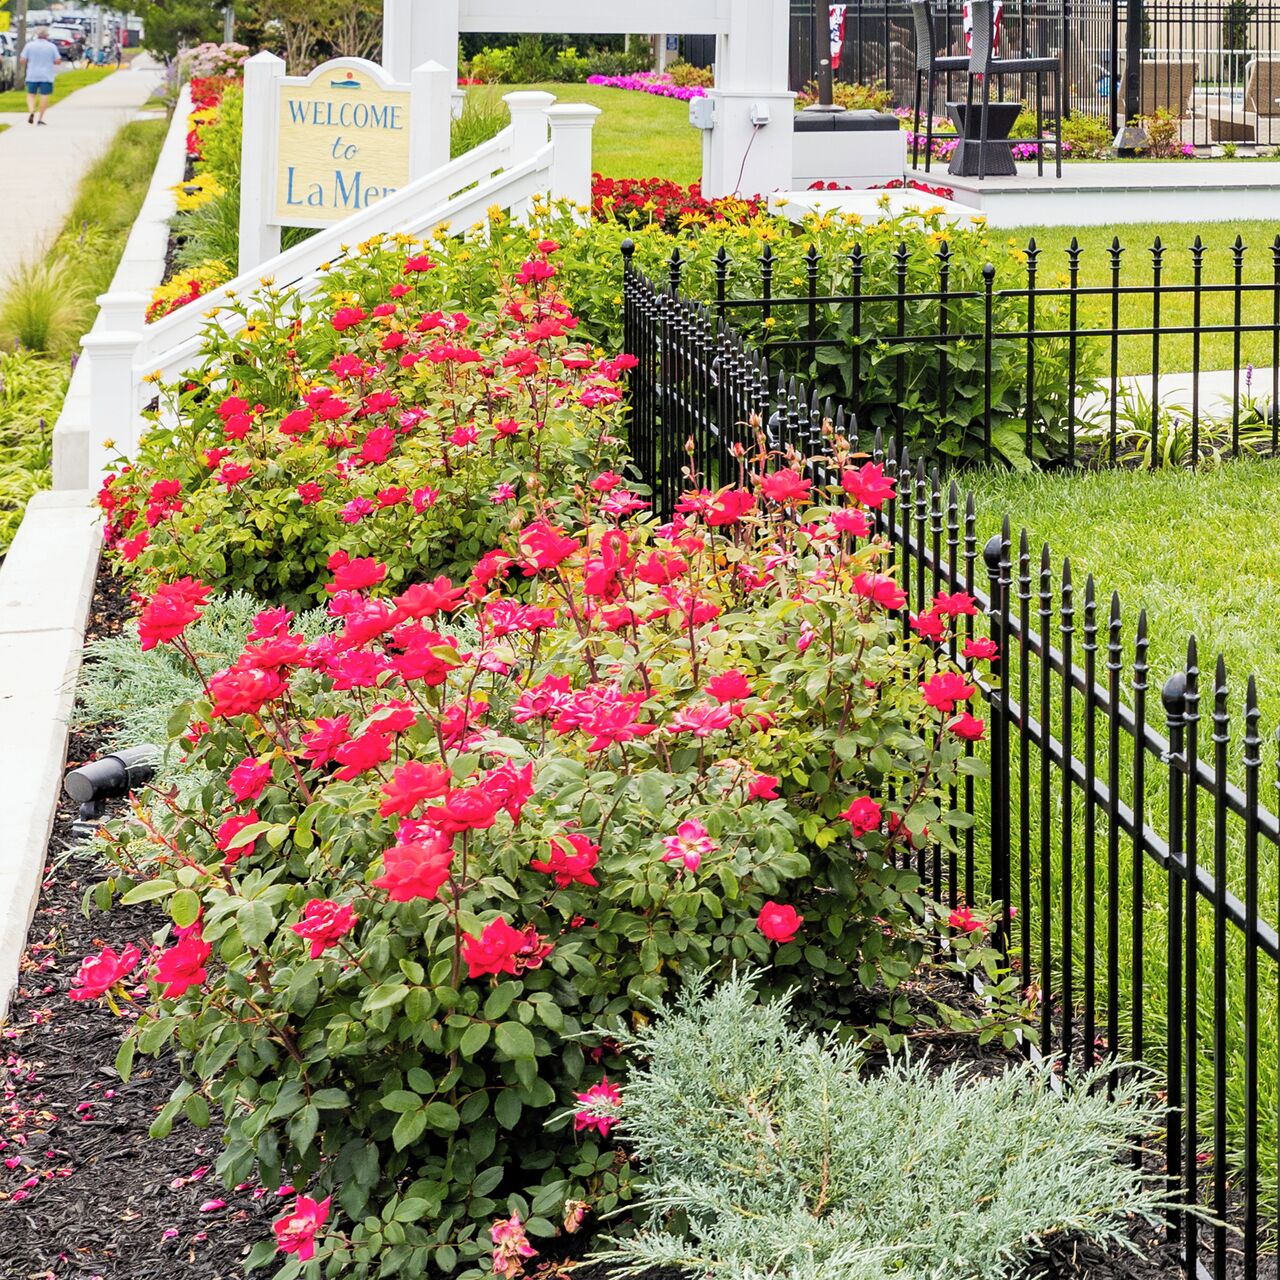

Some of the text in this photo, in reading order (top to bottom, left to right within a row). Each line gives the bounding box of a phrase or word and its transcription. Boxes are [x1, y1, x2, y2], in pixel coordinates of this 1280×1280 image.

[288, 100, 403, 130] WELCOME
[331, 136, 360, 160] to
[287, 166, 323, 207] La
